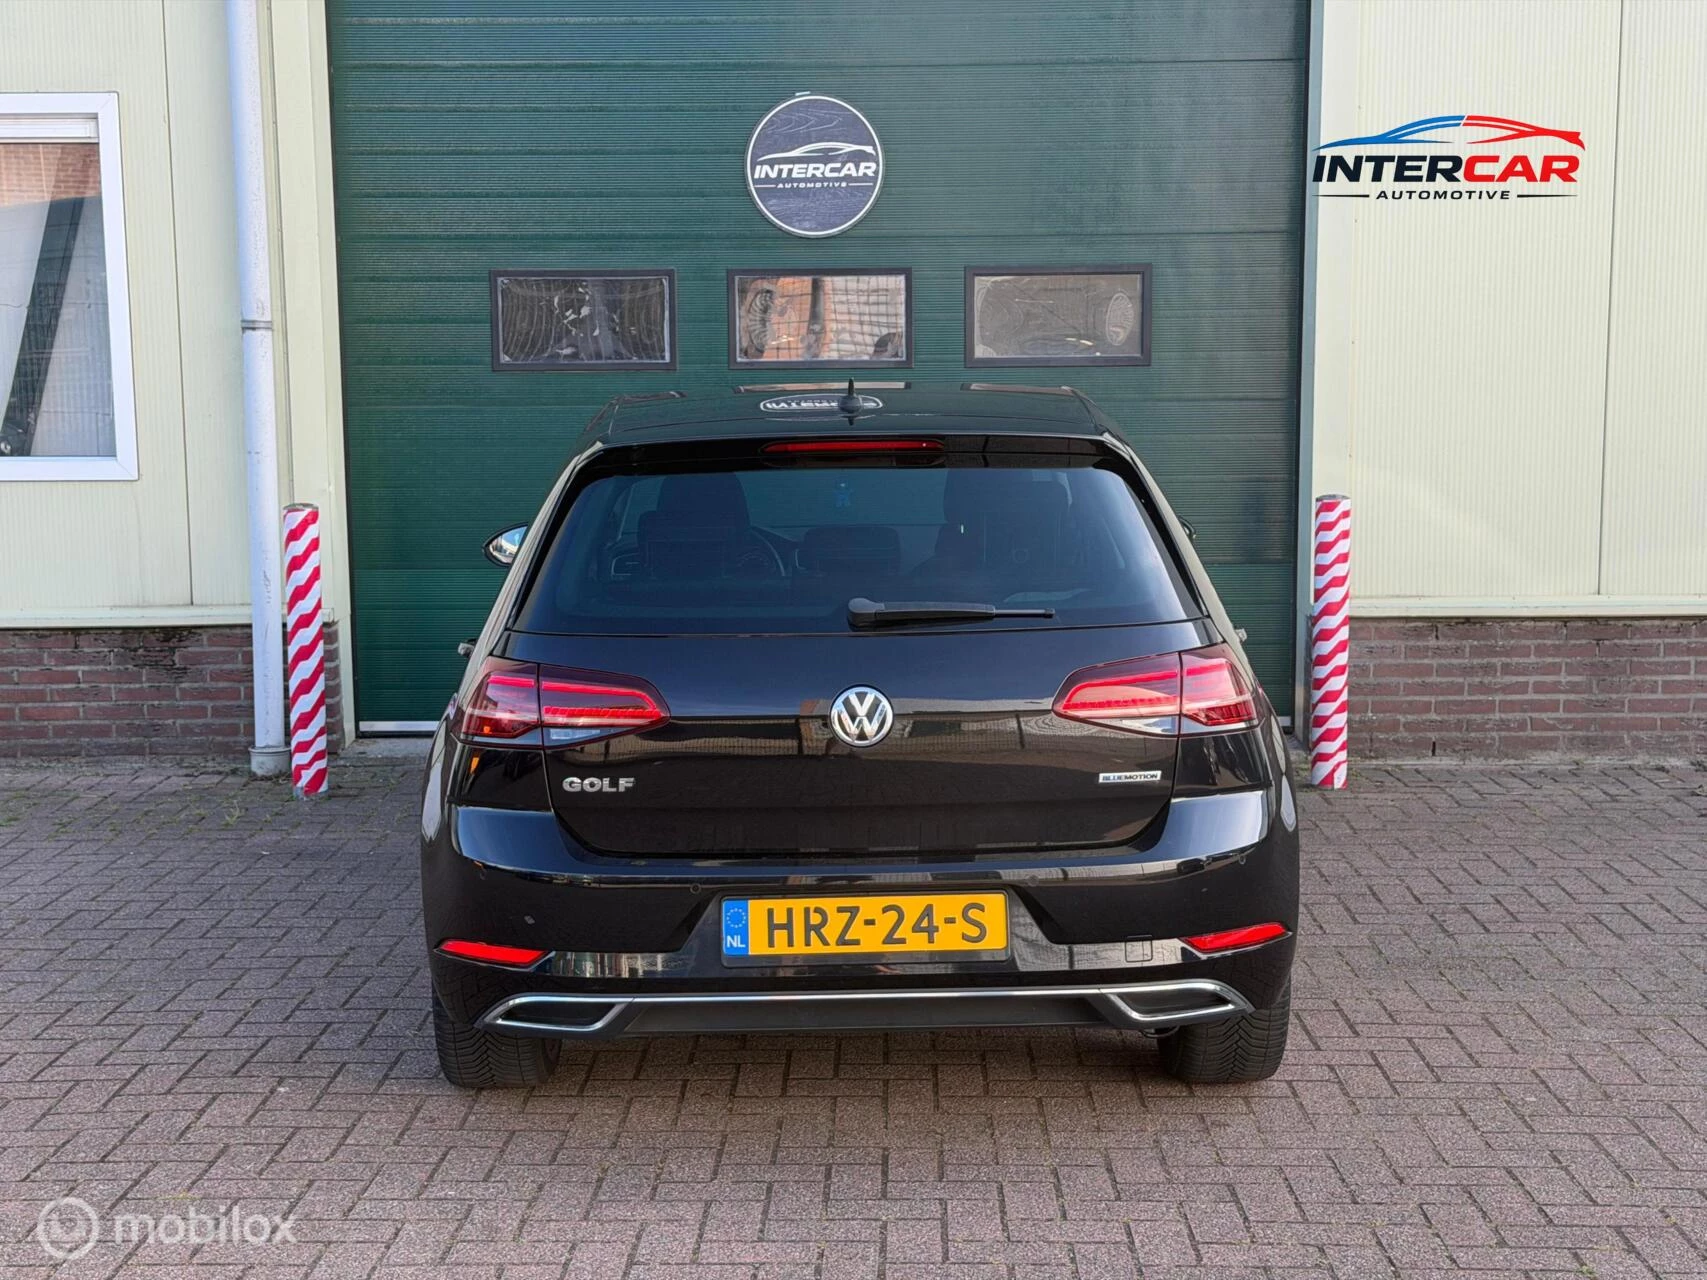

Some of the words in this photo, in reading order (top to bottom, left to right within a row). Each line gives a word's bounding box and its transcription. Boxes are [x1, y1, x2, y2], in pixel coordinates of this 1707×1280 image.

[753, 162, 877, 179] INTERCAR
[562, 776, 636, 793] GOLF
[766, 902, 988, 948] HRZ-24-S
[727, 935, 746, 948] NL
